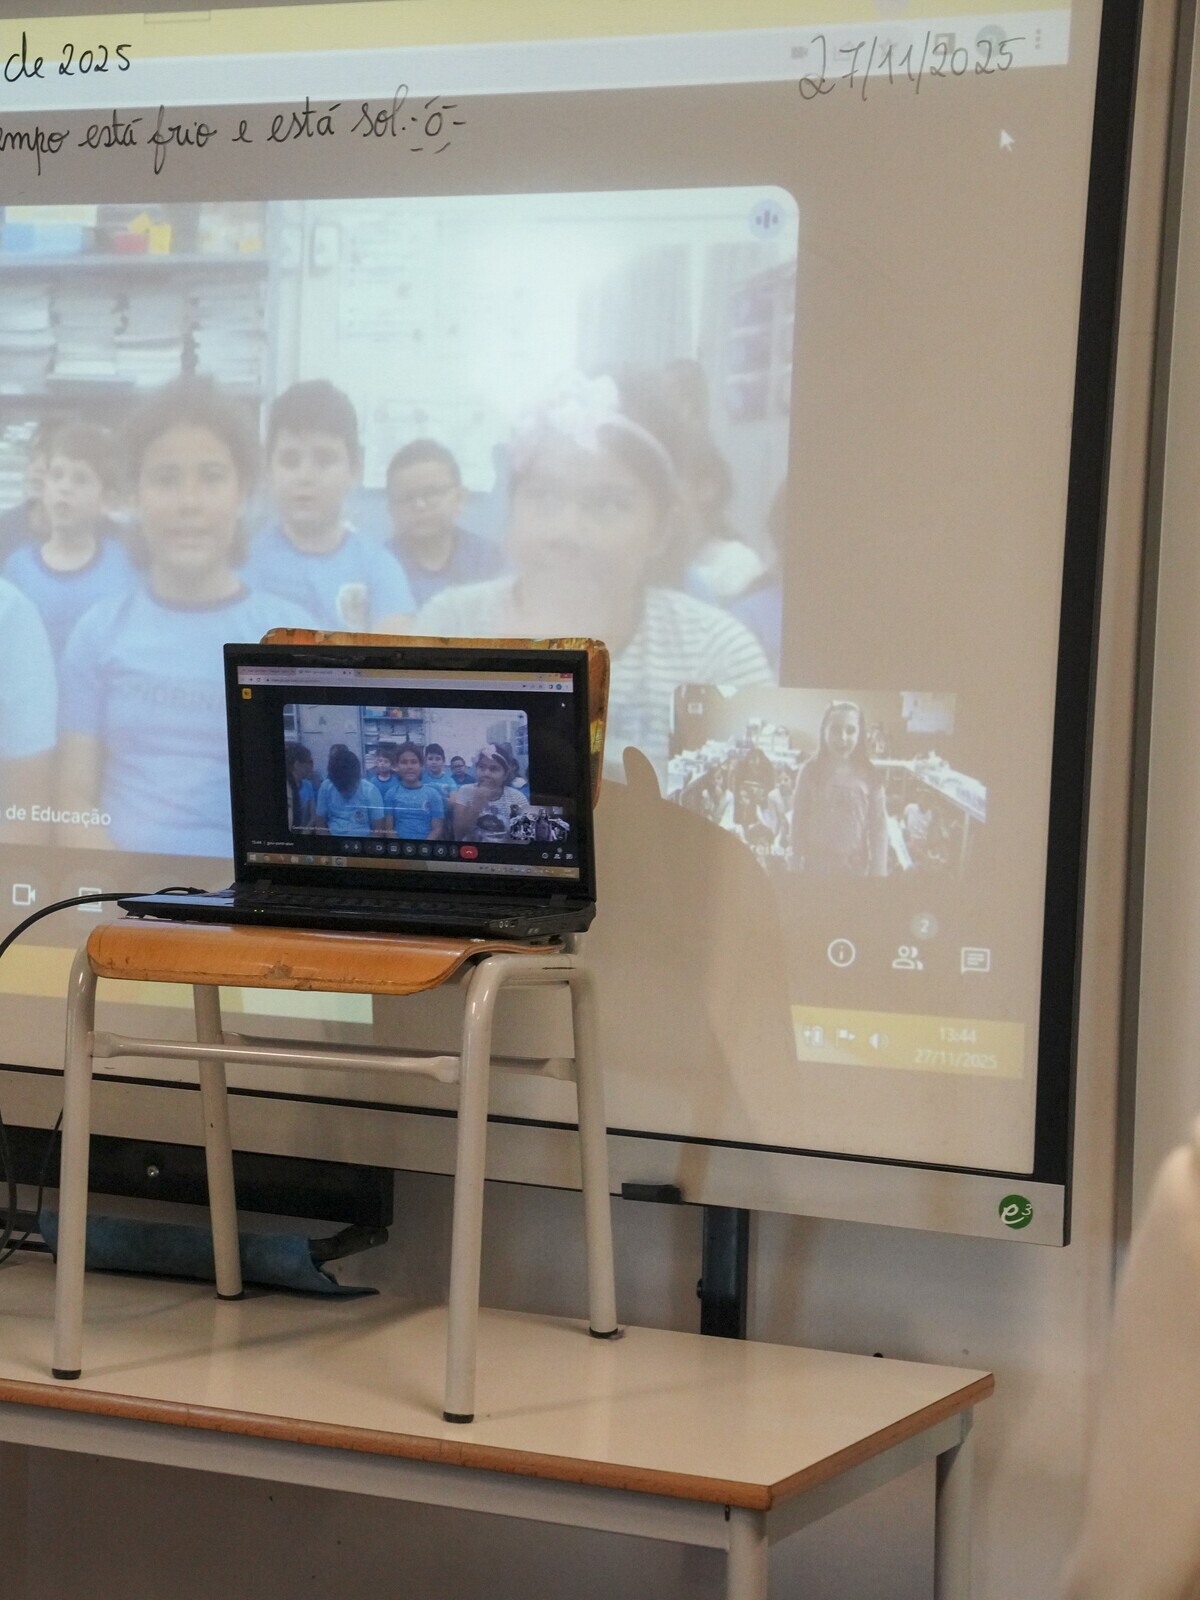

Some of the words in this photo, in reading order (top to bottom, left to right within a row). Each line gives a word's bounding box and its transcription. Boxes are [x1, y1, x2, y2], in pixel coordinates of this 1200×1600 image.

[4, 31, 46, 82] de
[58, 43, 132, 75] 2025
[799, 31, 1026, 101] 27/11/2025
[78, 109, 143, 149] está
[147, 104, 218, 175] frio
[232, 119, 253, 143] e
[267, 96, 342, 143] está
[5, 804, 26, 821] de
[31, 805, 112, 828] Educação
